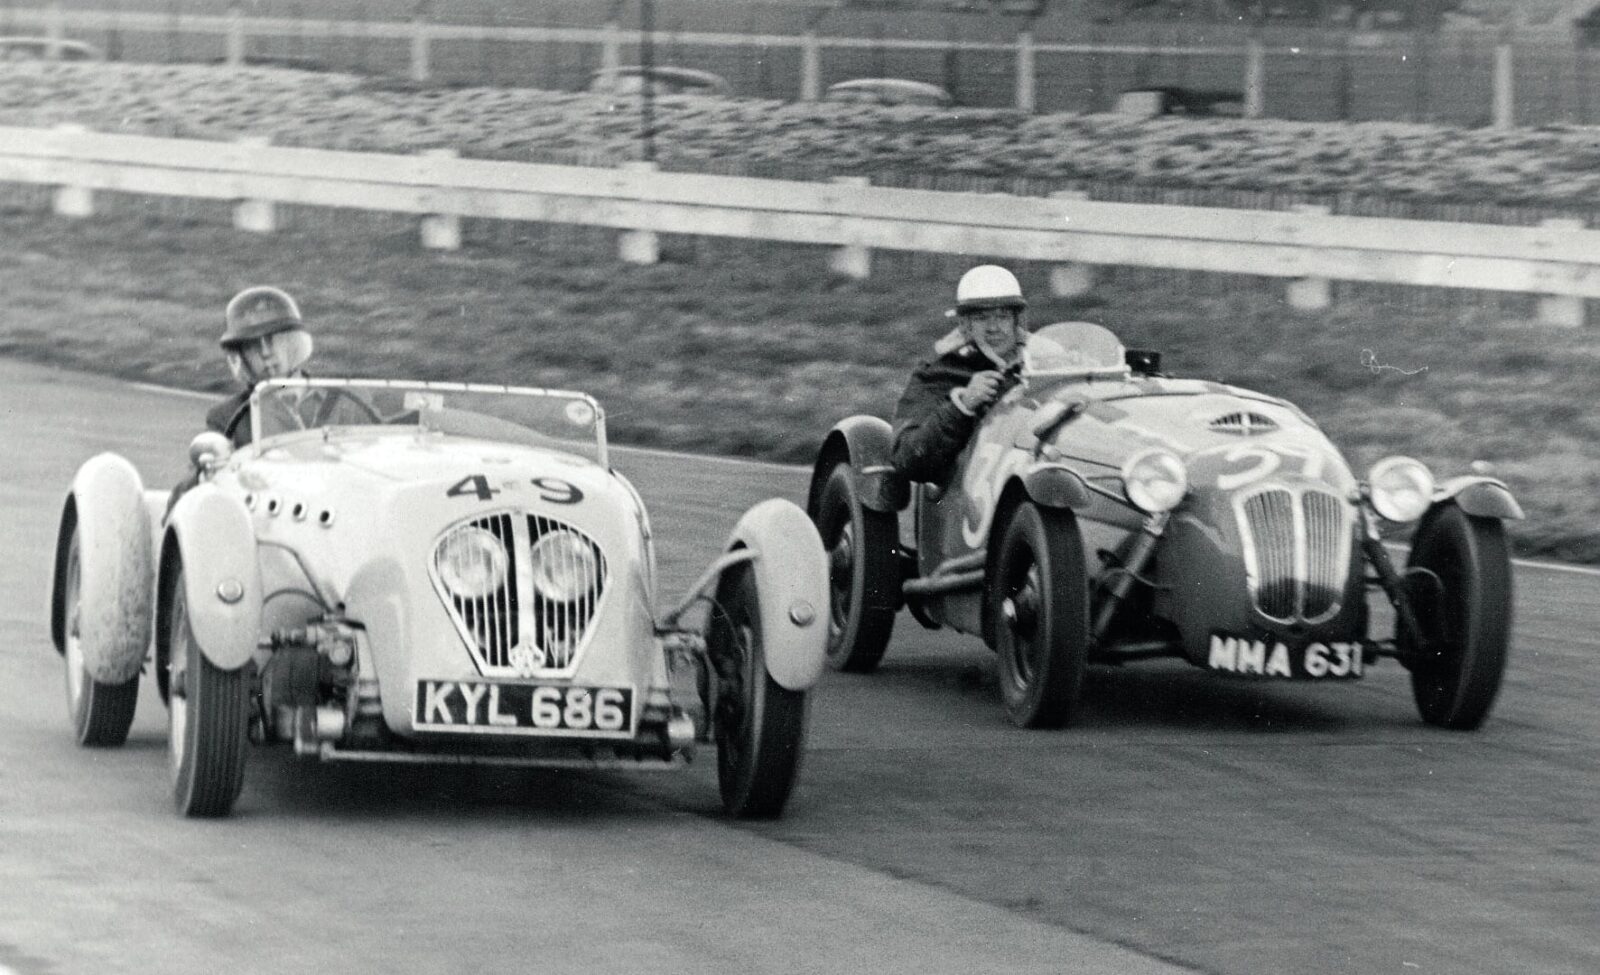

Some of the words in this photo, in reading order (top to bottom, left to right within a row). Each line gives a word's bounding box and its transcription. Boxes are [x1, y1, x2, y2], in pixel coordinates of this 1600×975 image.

[1208, 635, 1292, 678] MMA
[1304, 641, 1364, 678] 631
[424, 680, 518, 728] KYL
[531, 685, 625, 731] 686
